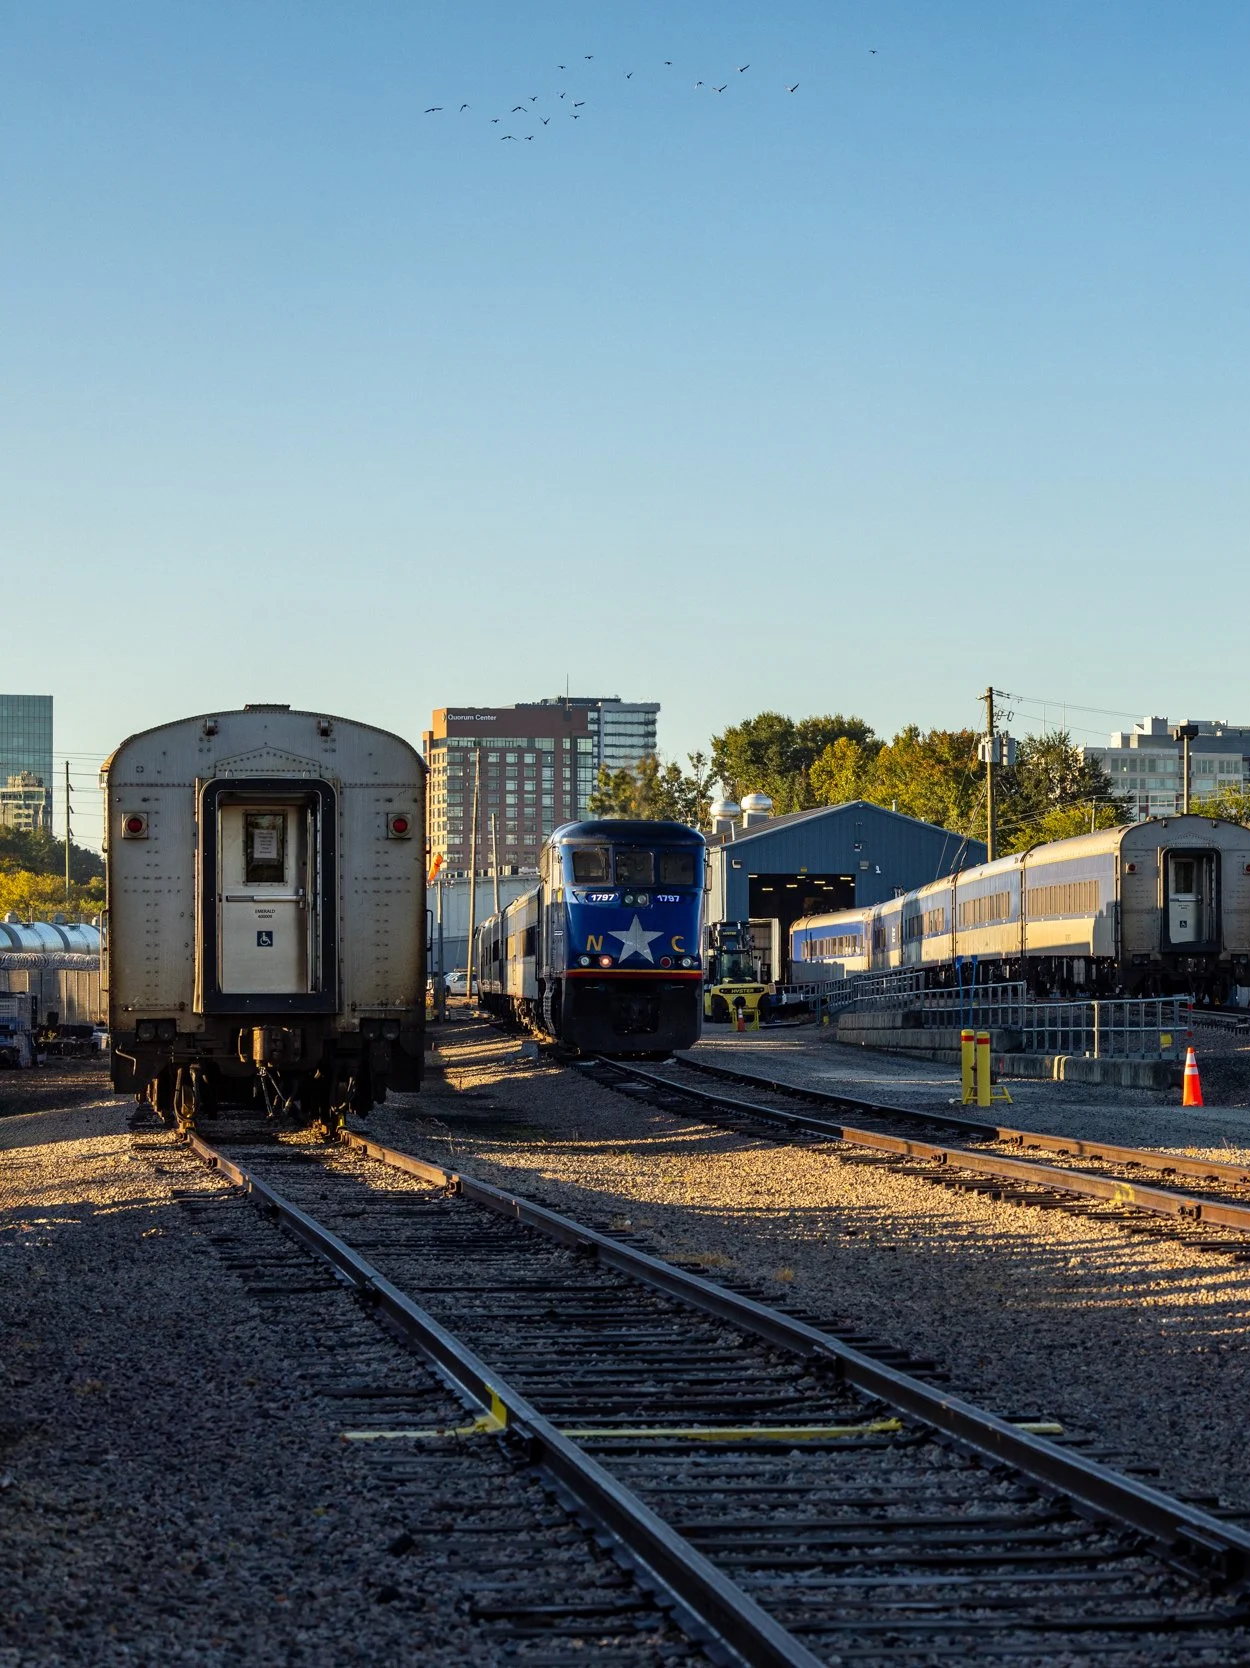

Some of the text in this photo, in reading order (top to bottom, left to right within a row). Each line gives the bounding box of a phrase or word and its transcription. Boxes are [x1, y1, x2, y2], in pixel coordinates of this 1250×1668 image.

[591, 893, 614, 901] 1797
[657, 894, 680, 903] 1797
[586, 934, 686, 953] N C
